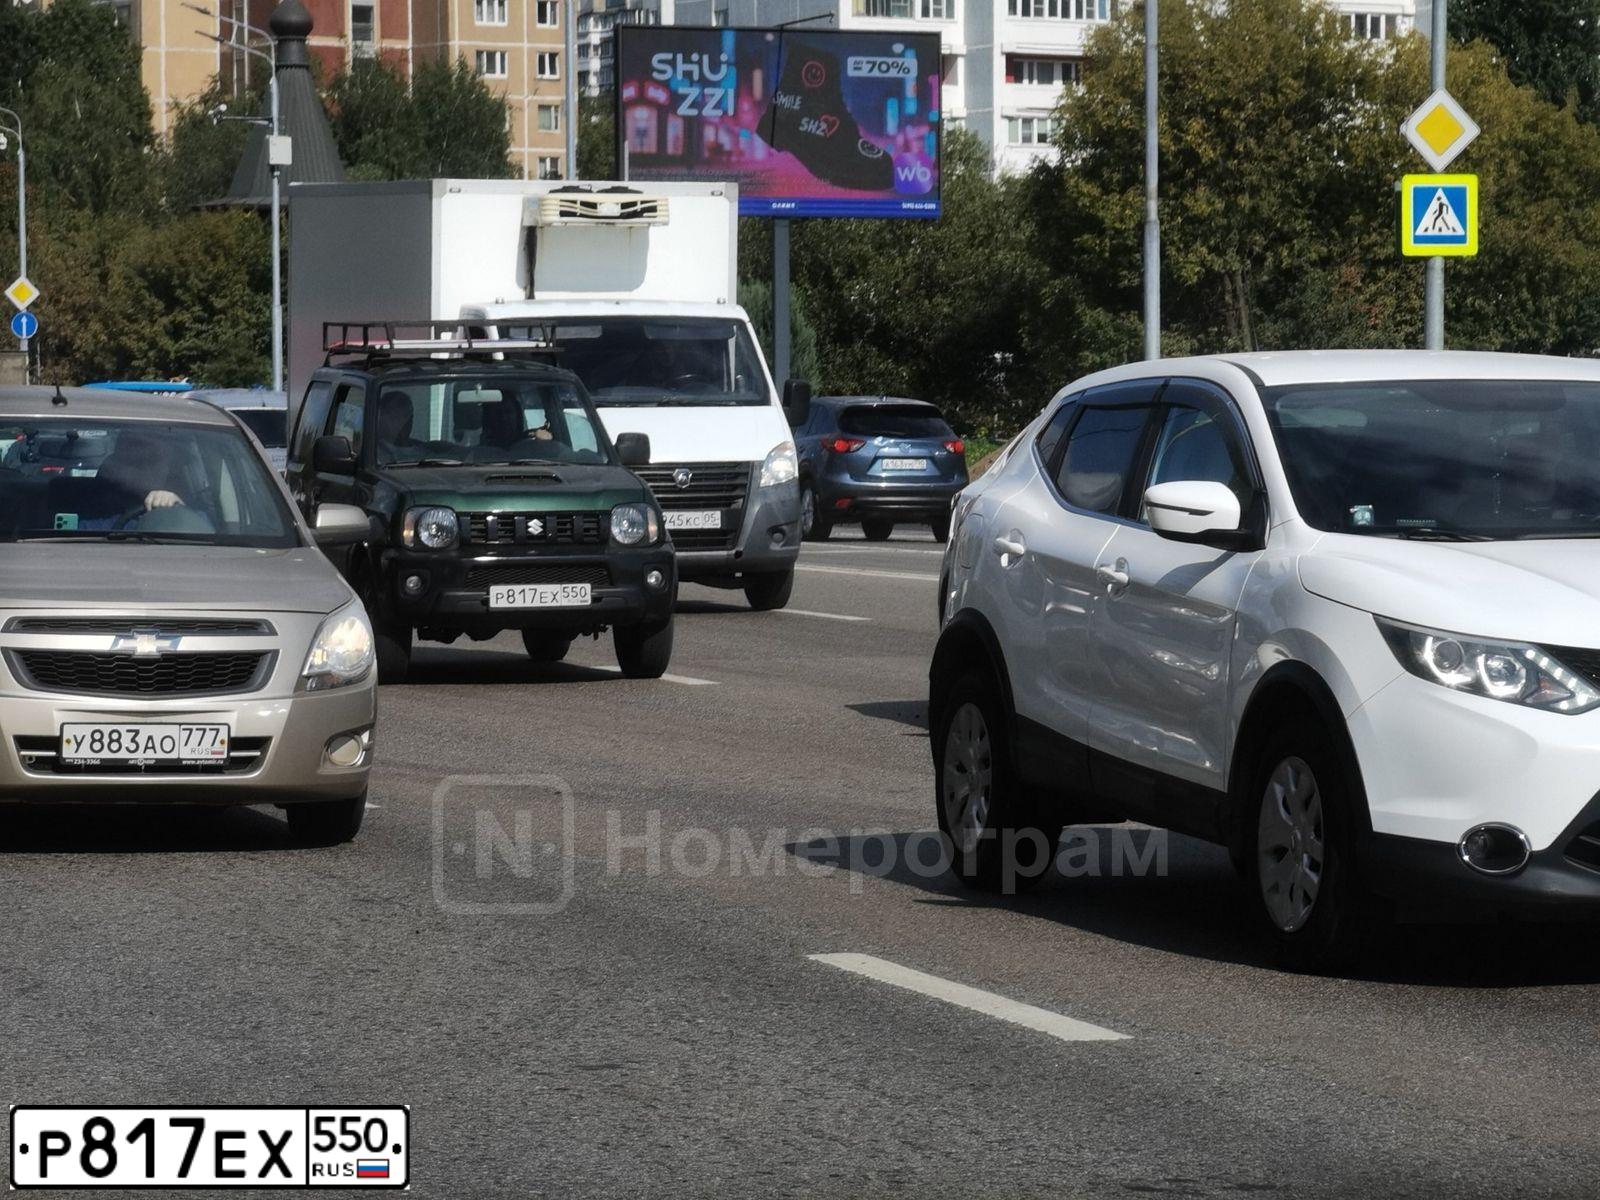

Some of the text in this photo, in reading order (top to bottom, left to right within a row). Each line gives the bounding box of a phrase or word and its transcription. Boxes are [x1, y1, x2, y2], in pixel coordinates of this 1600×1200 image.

[651, 52, 728, 81] SHU
[495, 586, 587, 605] Р817ЕХ 550
[73, 727, 220, 754] У883АО 777
